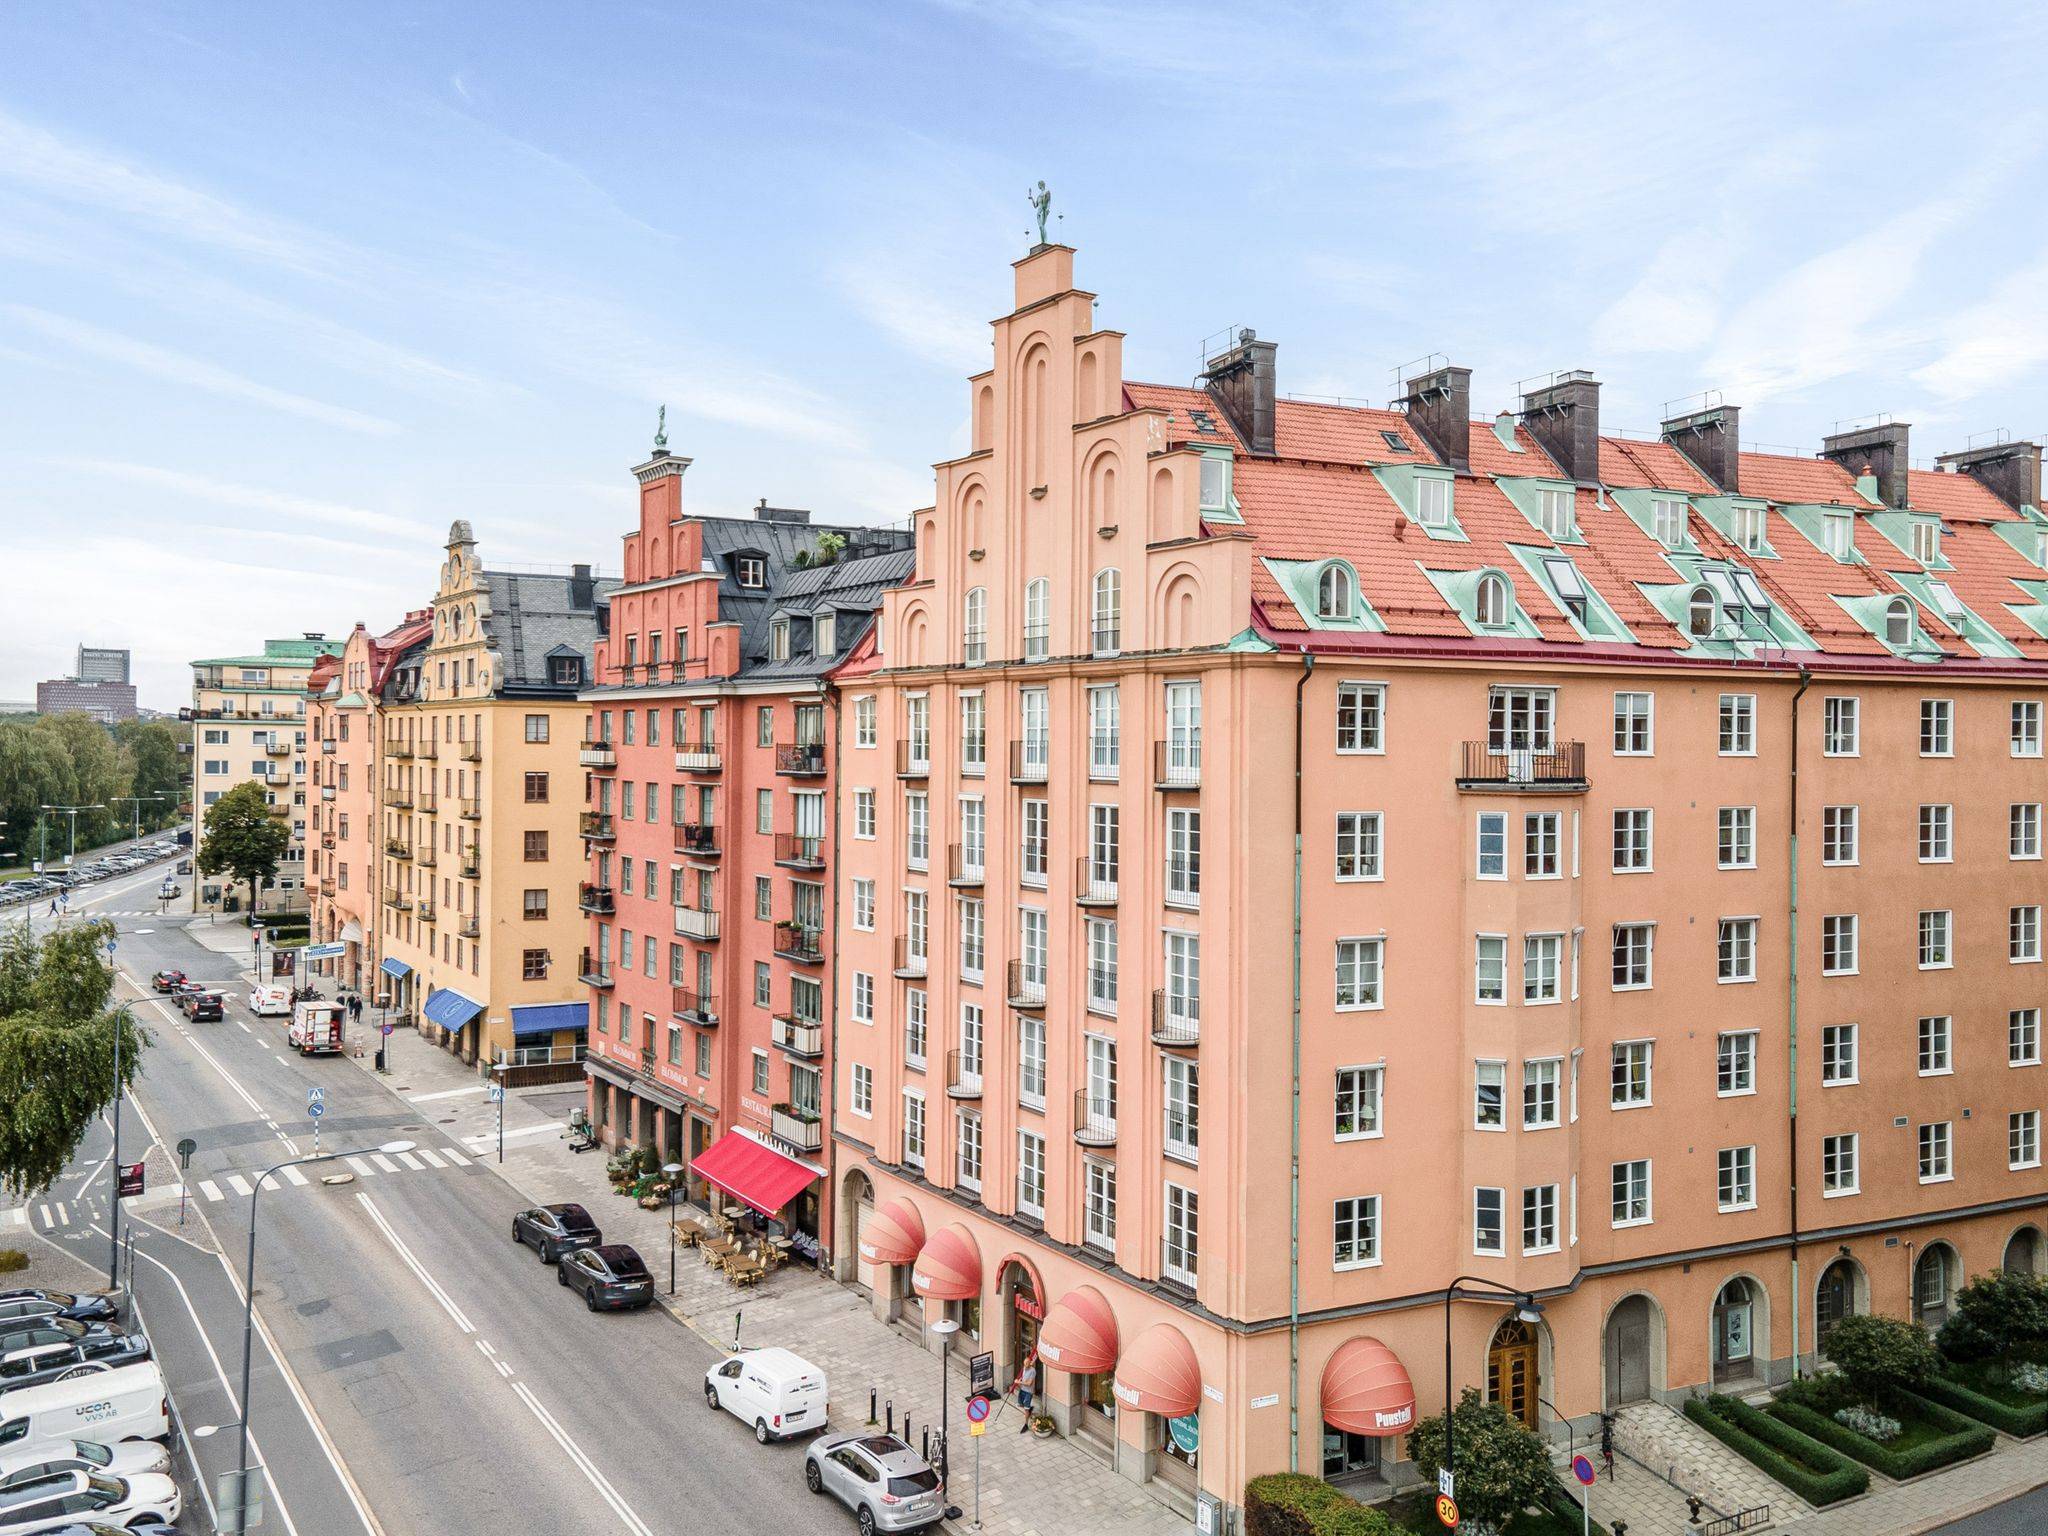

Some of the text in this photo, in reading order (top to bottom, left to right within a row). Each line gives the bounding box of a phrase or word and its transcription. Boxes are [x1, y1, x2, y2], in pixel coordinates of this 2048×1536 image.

[756, 1129, 795, 1158] ITALIANA
[85, 1414, 104, 1422] VVS
[1440, 1502, 1455, 1520] 30
